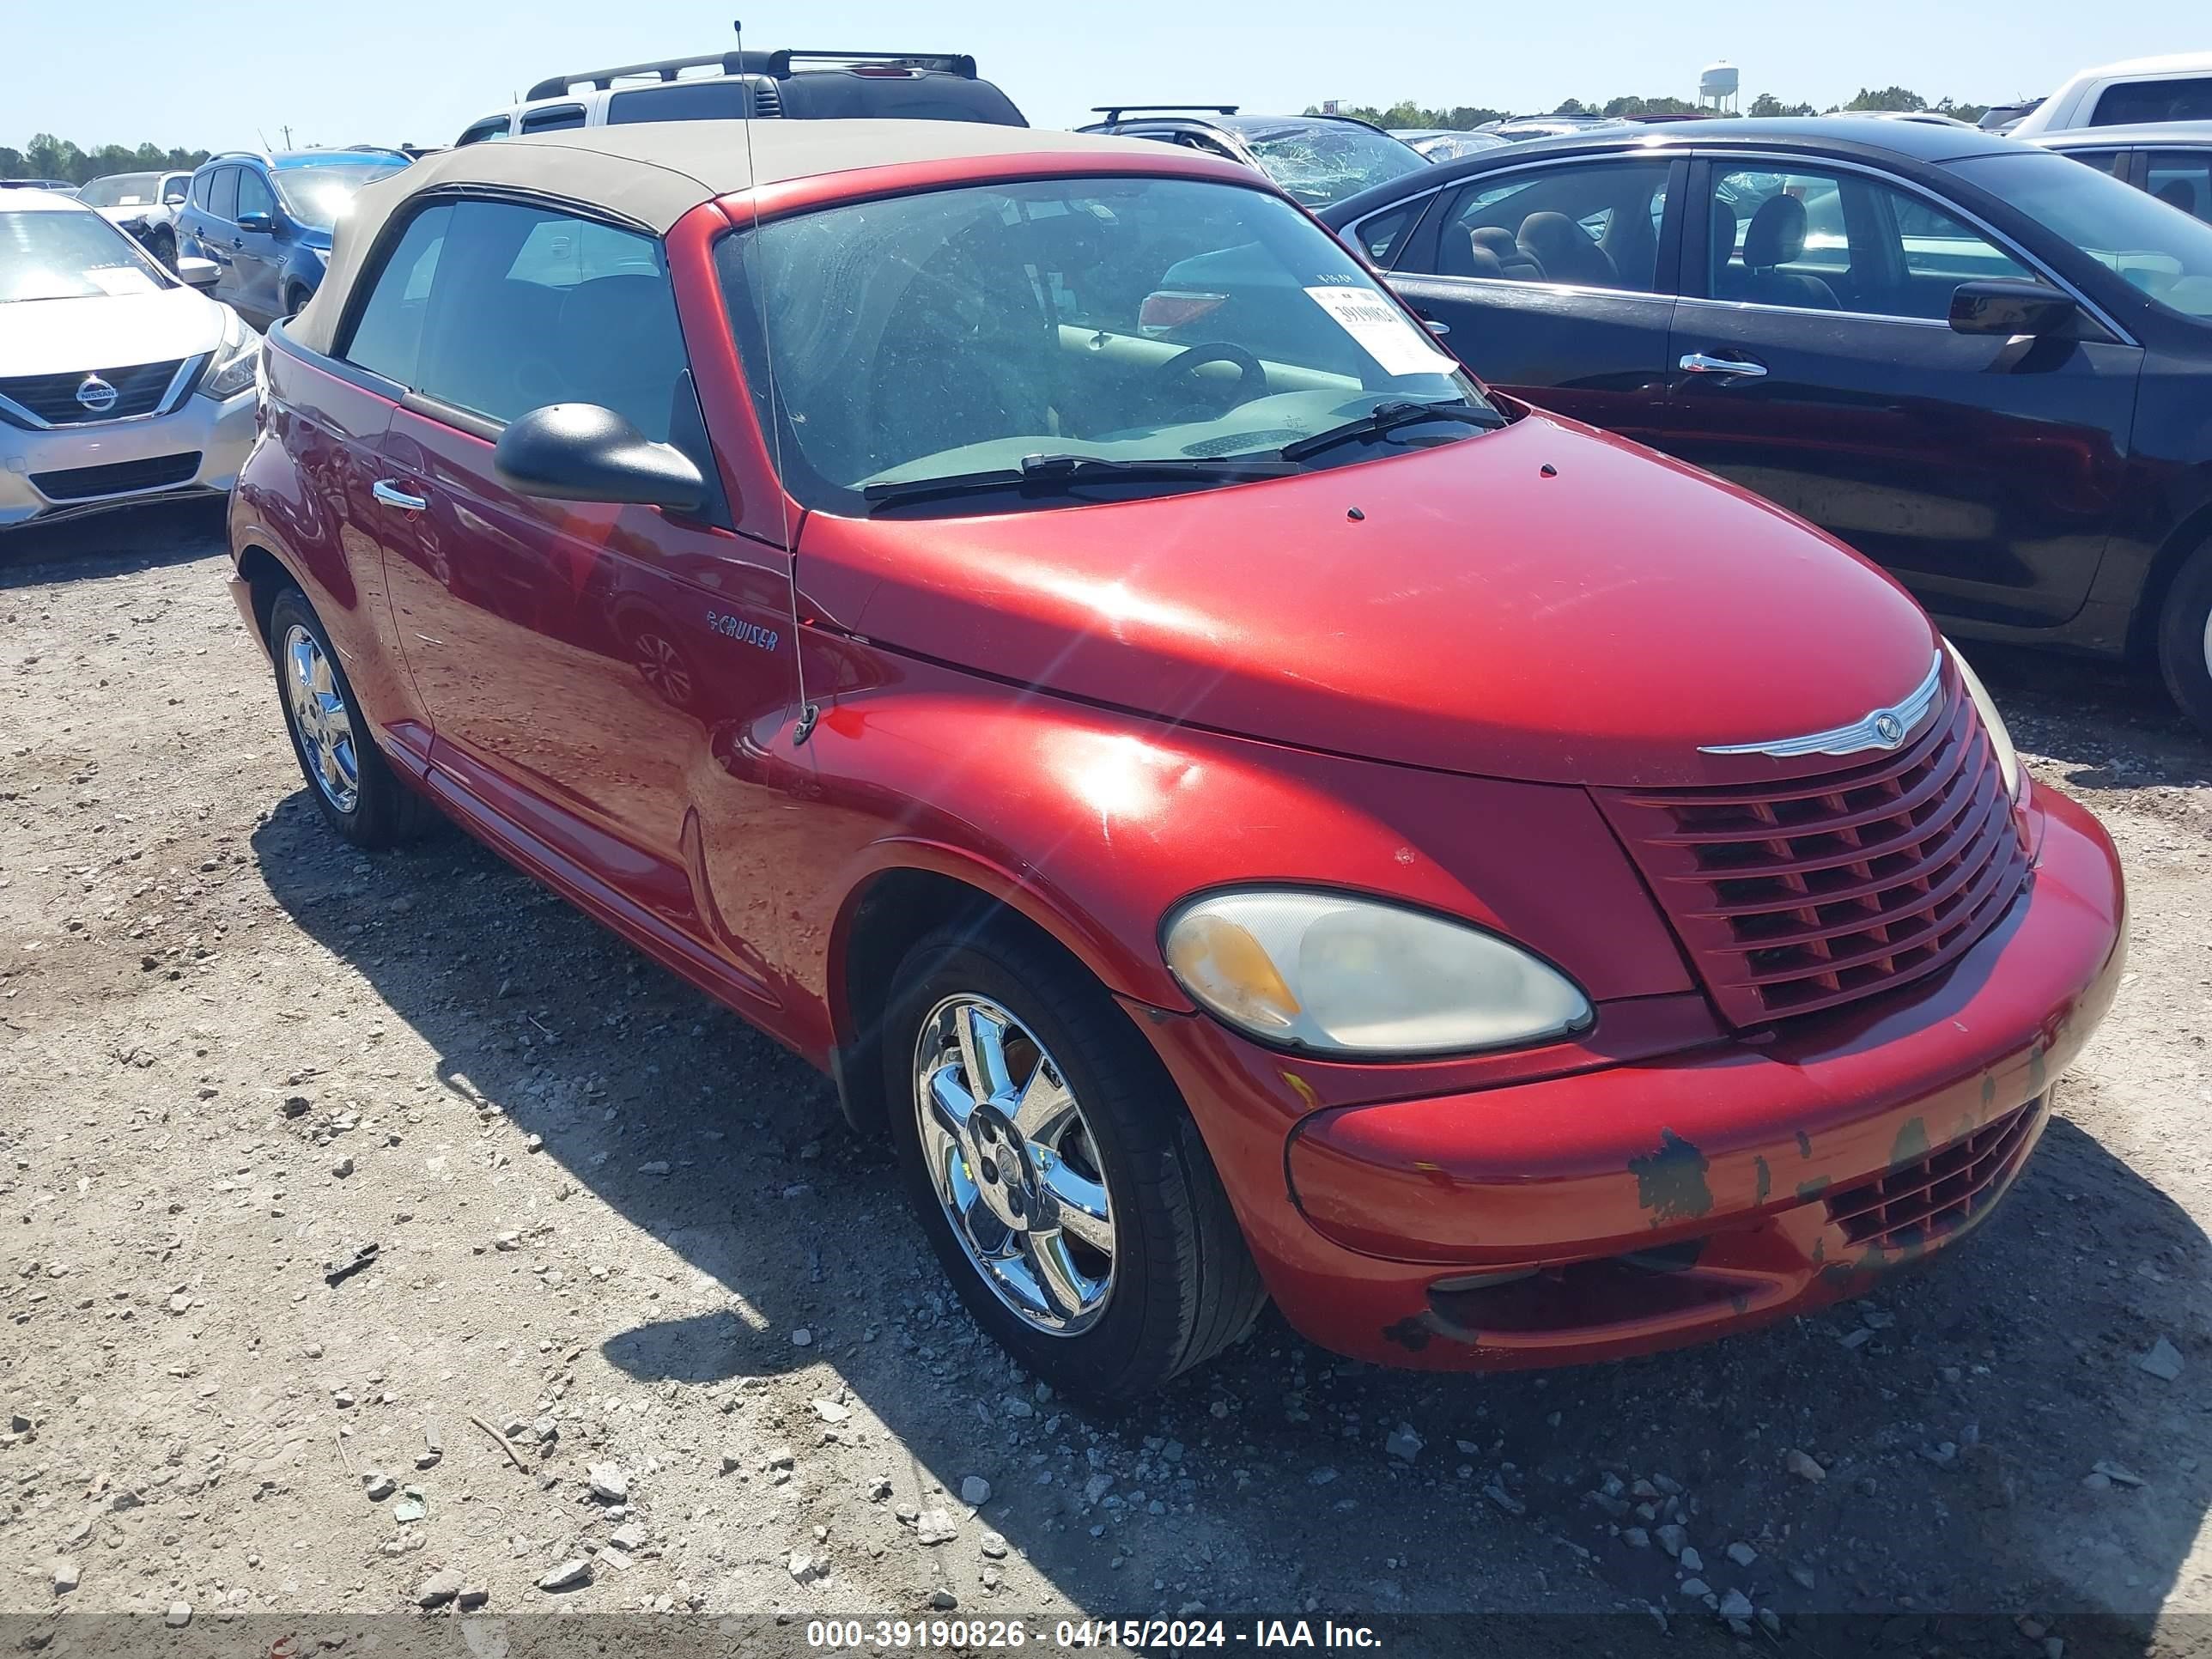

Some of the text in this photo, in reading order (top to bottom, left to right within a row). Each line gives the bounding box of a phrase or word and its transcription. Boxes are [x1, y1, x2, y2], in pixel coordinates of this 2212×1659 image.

[1323, 104, 1334, 114] 30
[1334, 306, 1399, 323] 39190826
[719, 615, 779, 651] CRUISER
